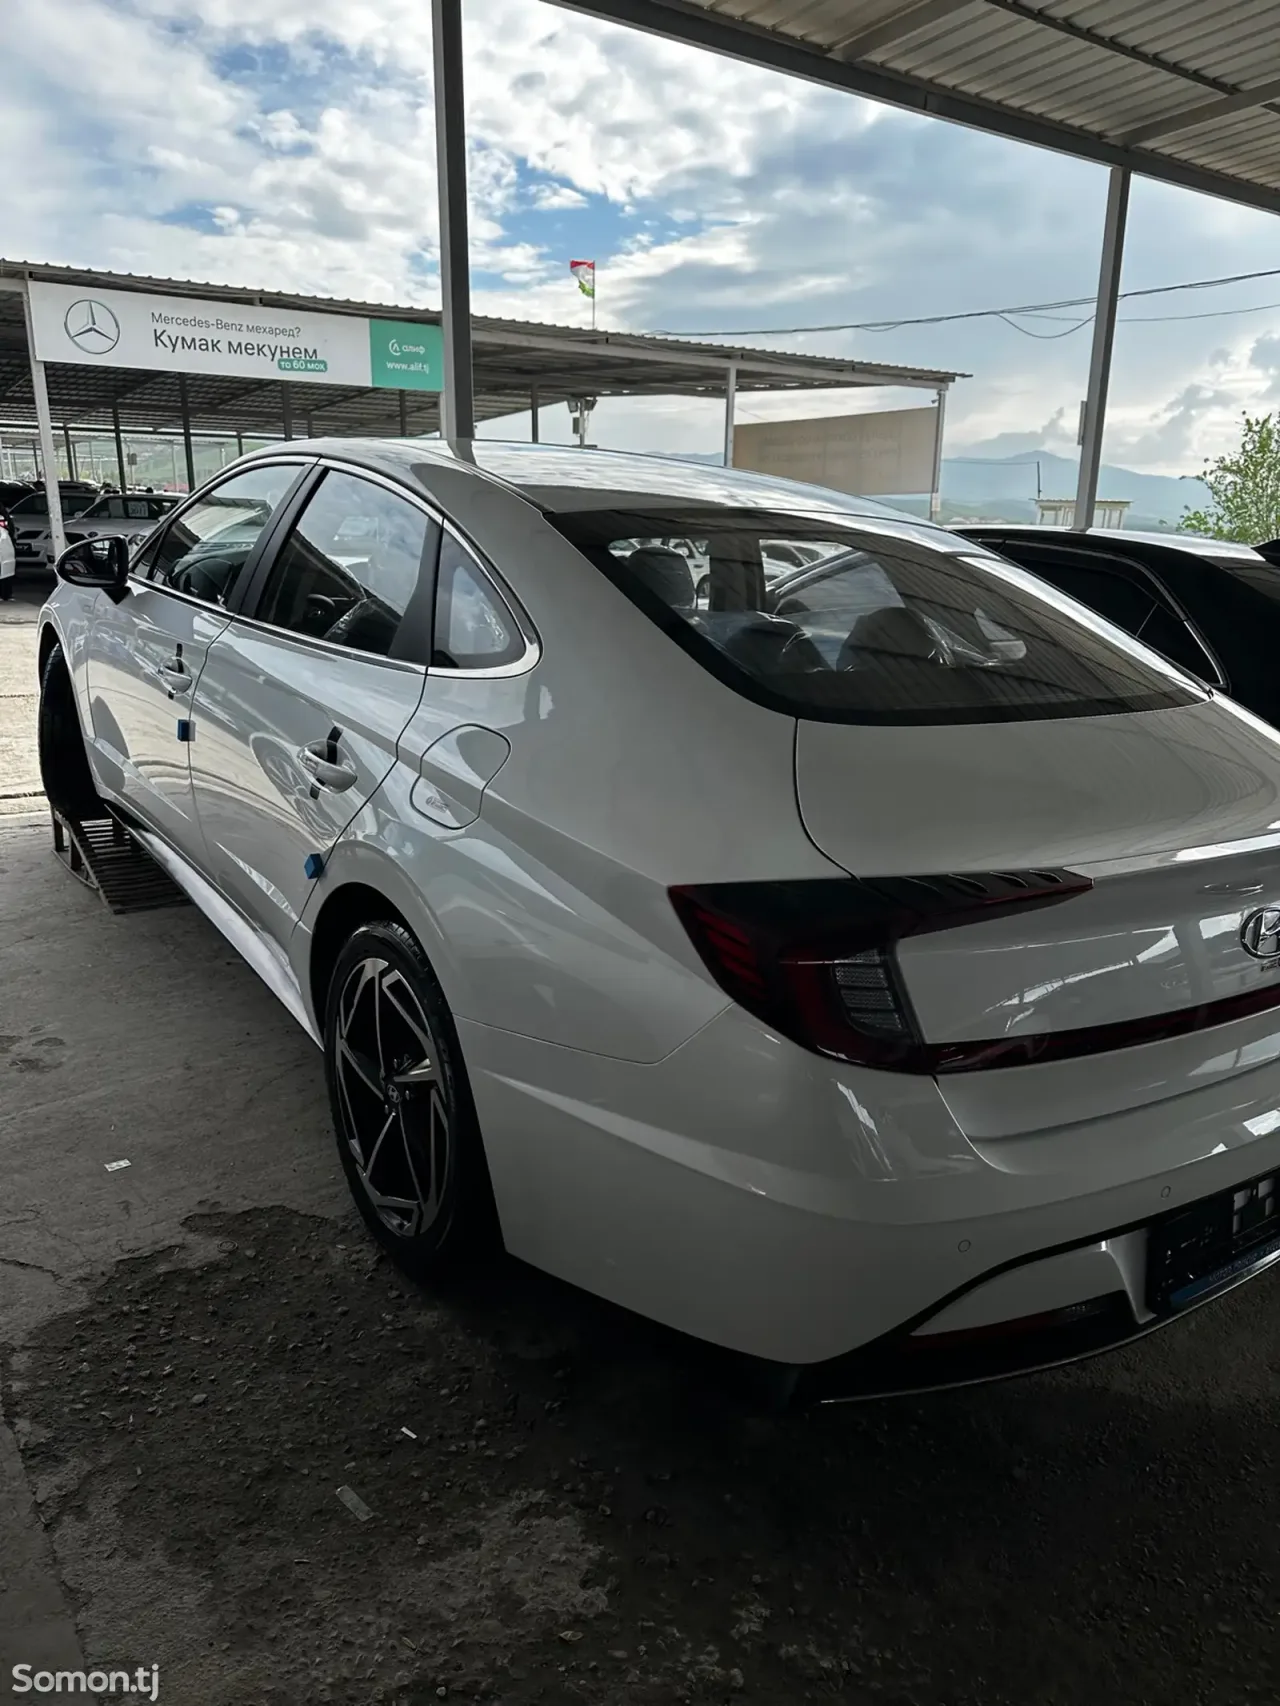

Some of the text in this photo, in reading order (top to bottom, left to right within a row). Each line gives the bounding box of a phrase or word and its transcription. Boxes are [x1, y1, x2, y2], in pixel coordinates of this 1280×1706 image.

[151, 312, 302, 338] Mercedes-Benz мехаред?
[153, 328, 318, 362] Кумак мекунем
[293, 360, 306, 369] 60
